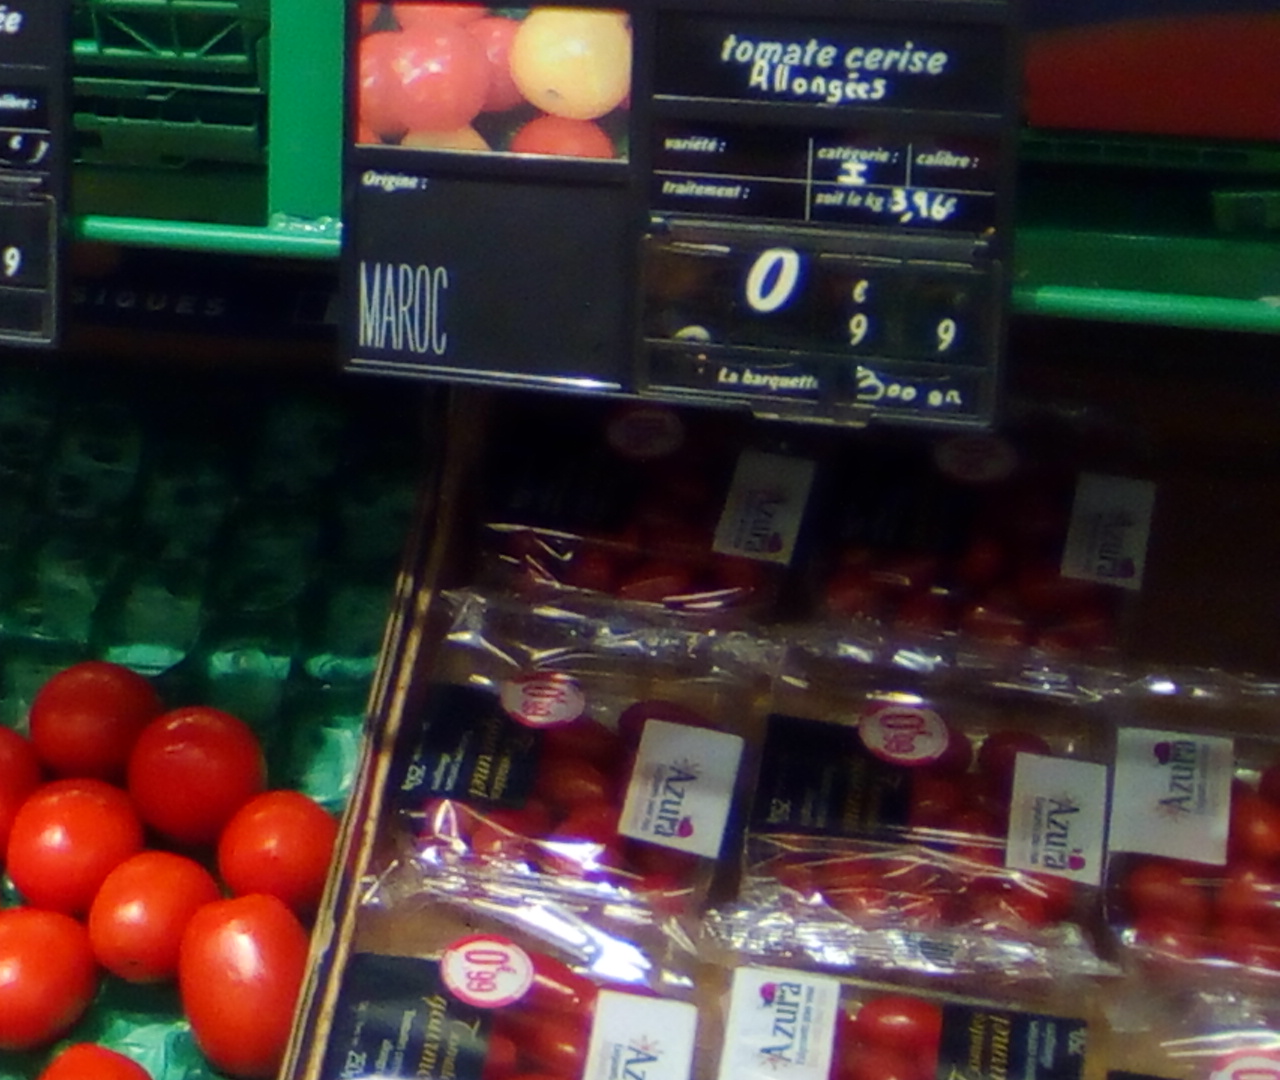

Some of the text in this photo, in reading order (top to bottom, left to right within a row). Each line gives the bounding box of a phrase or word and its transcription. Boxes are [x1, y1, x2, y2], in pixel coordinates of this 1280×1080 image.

[720, 33, 948, 75] tomate cerise
[358, 259, 450, 356] MAROC
[652, 762, 698, 839] Azura
[1157, 739, 1198, 815] Azura
[1043, 798, 1081, 872] Azura
[760, 981, 803, 1064] Azura
